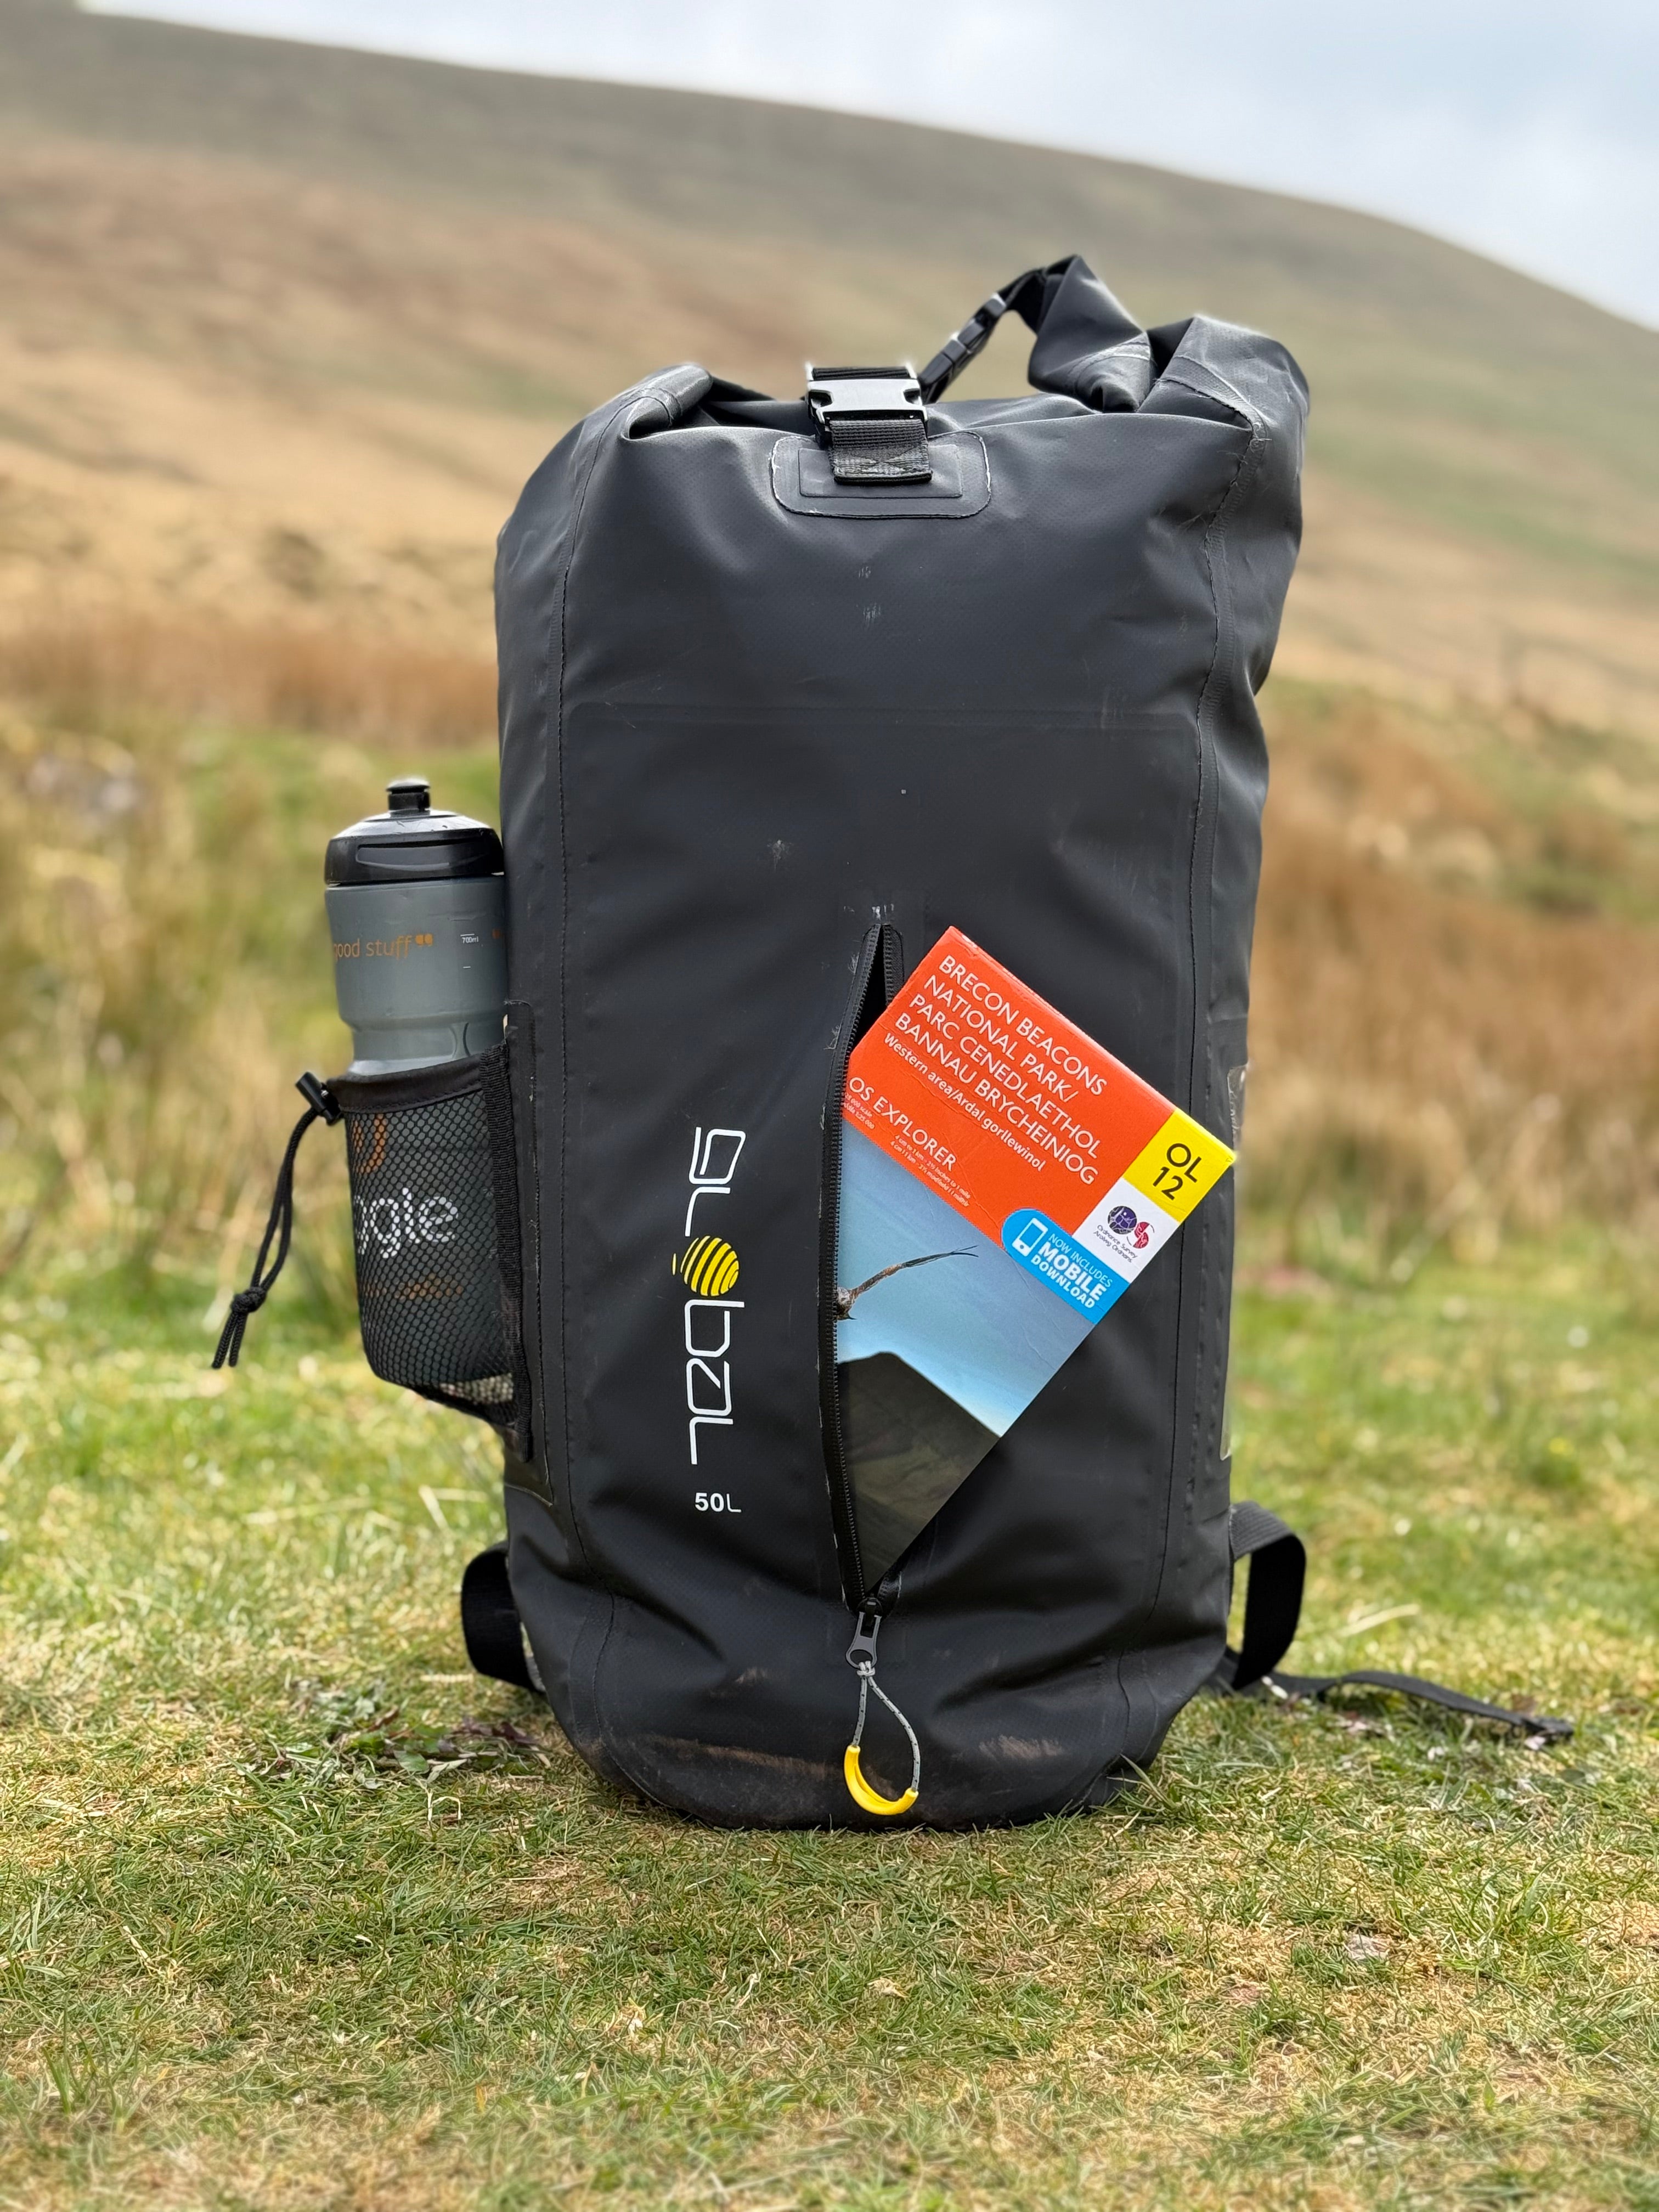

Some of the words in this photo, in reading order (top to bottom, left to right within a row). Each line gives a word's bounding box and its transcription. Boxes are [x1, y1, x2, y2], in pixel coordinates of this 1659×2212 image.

[333, 938, 360, 962] good
[924, 974, 1018, 1060] NATIONAL
[1020, 1053, 1079, 1102] PARK/
[939, 955, 1019, 1025] BRECON
[1015, 1017, 1107, 1095] BEACONS
[884, 1032, 928, 1074] Western
[928, 1070, 985, 1121] area/Ardal
[981, 1118, 1046, 1171] gorllewinol
[895, 1013, 977, 1084] BANNAU
[974, 1079, 1098, 1184] BRYCHEINIOG
[910, 994, 960, 1040] PARC
[960, 1036, 1100, 1159] CENEDLAETHOL
[849, 1077, 874, 1101] OS
[873, 1096, 956, 1171] EXPLORER
[1152, 1166, 1183, 1201] 12
[1166, 1142, 1202, 1183] OL
[1037, 1241, 1107, 1301] MOBILE
[1048, 1233, 1072, 1254] NOW
[1070, 1250, 1113, 1288] INCLUDES
[1120, 1243, 1138, 1259] Survey
[1030, 1254, 1096, 1308] DOWNLOAD
[694, 1492, 742, 1514] 50L
